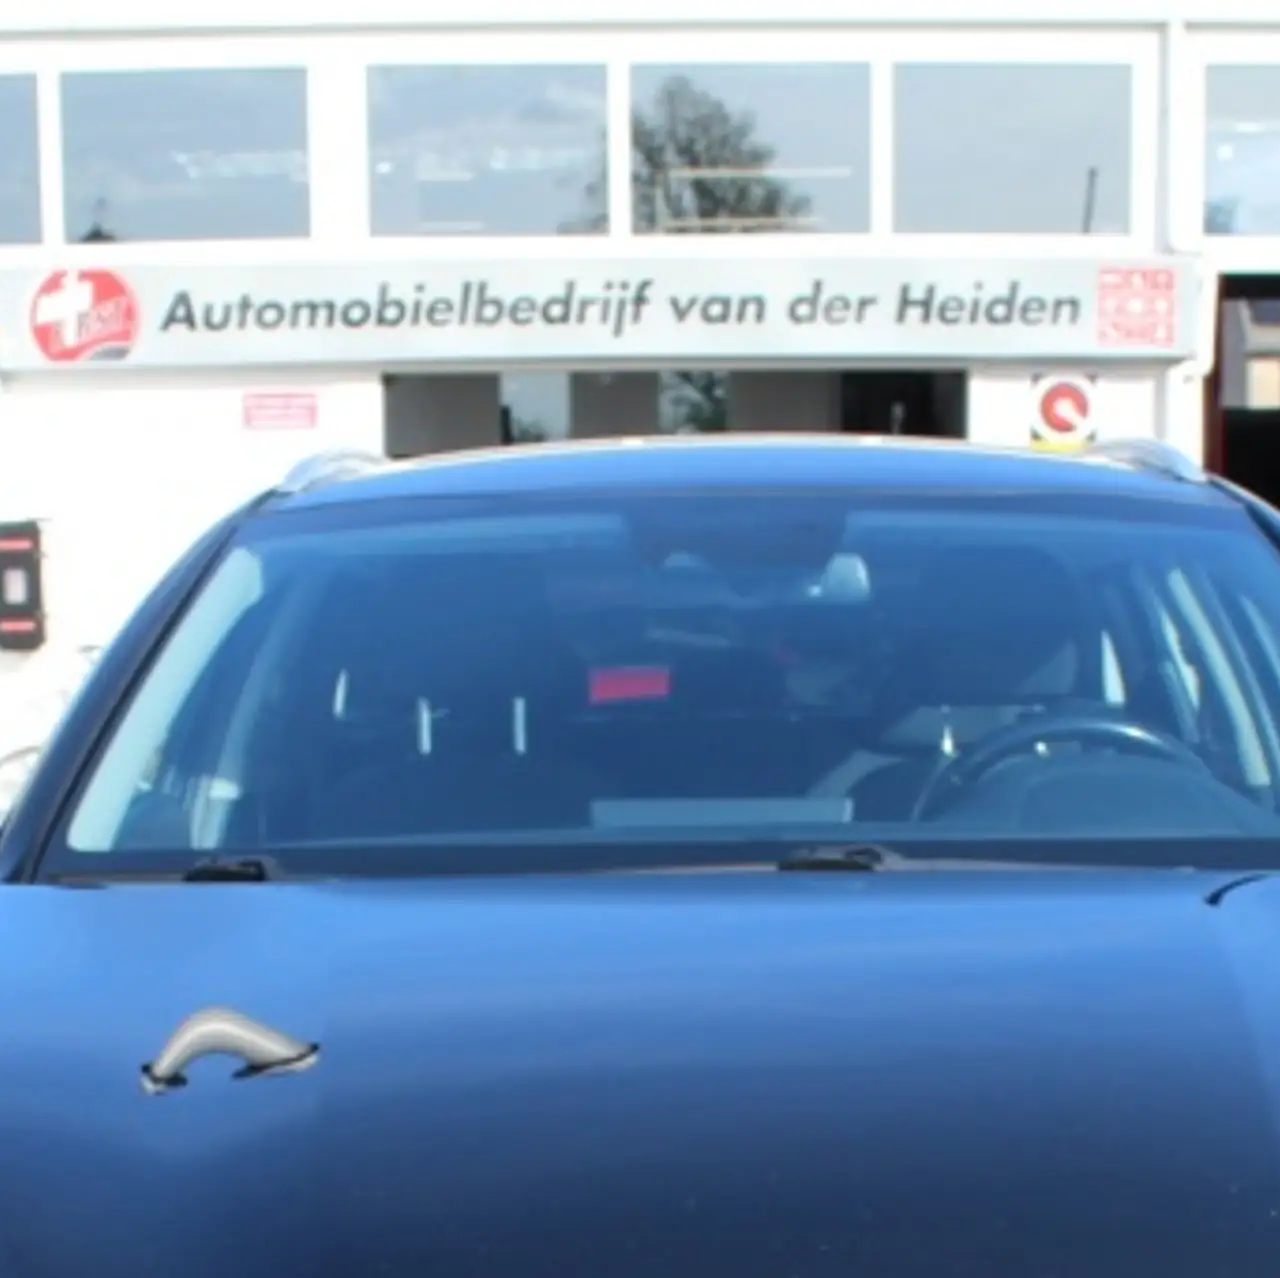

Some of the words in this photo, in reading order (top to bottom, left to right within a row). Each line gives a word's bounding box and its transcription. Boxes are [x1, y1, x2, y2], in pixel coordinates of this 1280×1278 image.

[160, 277, 655, 339] Automobielbedrijf
[667, 295, 767, 325] van
[787, 279, 878, 325] der
[894, 280, 1082, 325] Heiden
